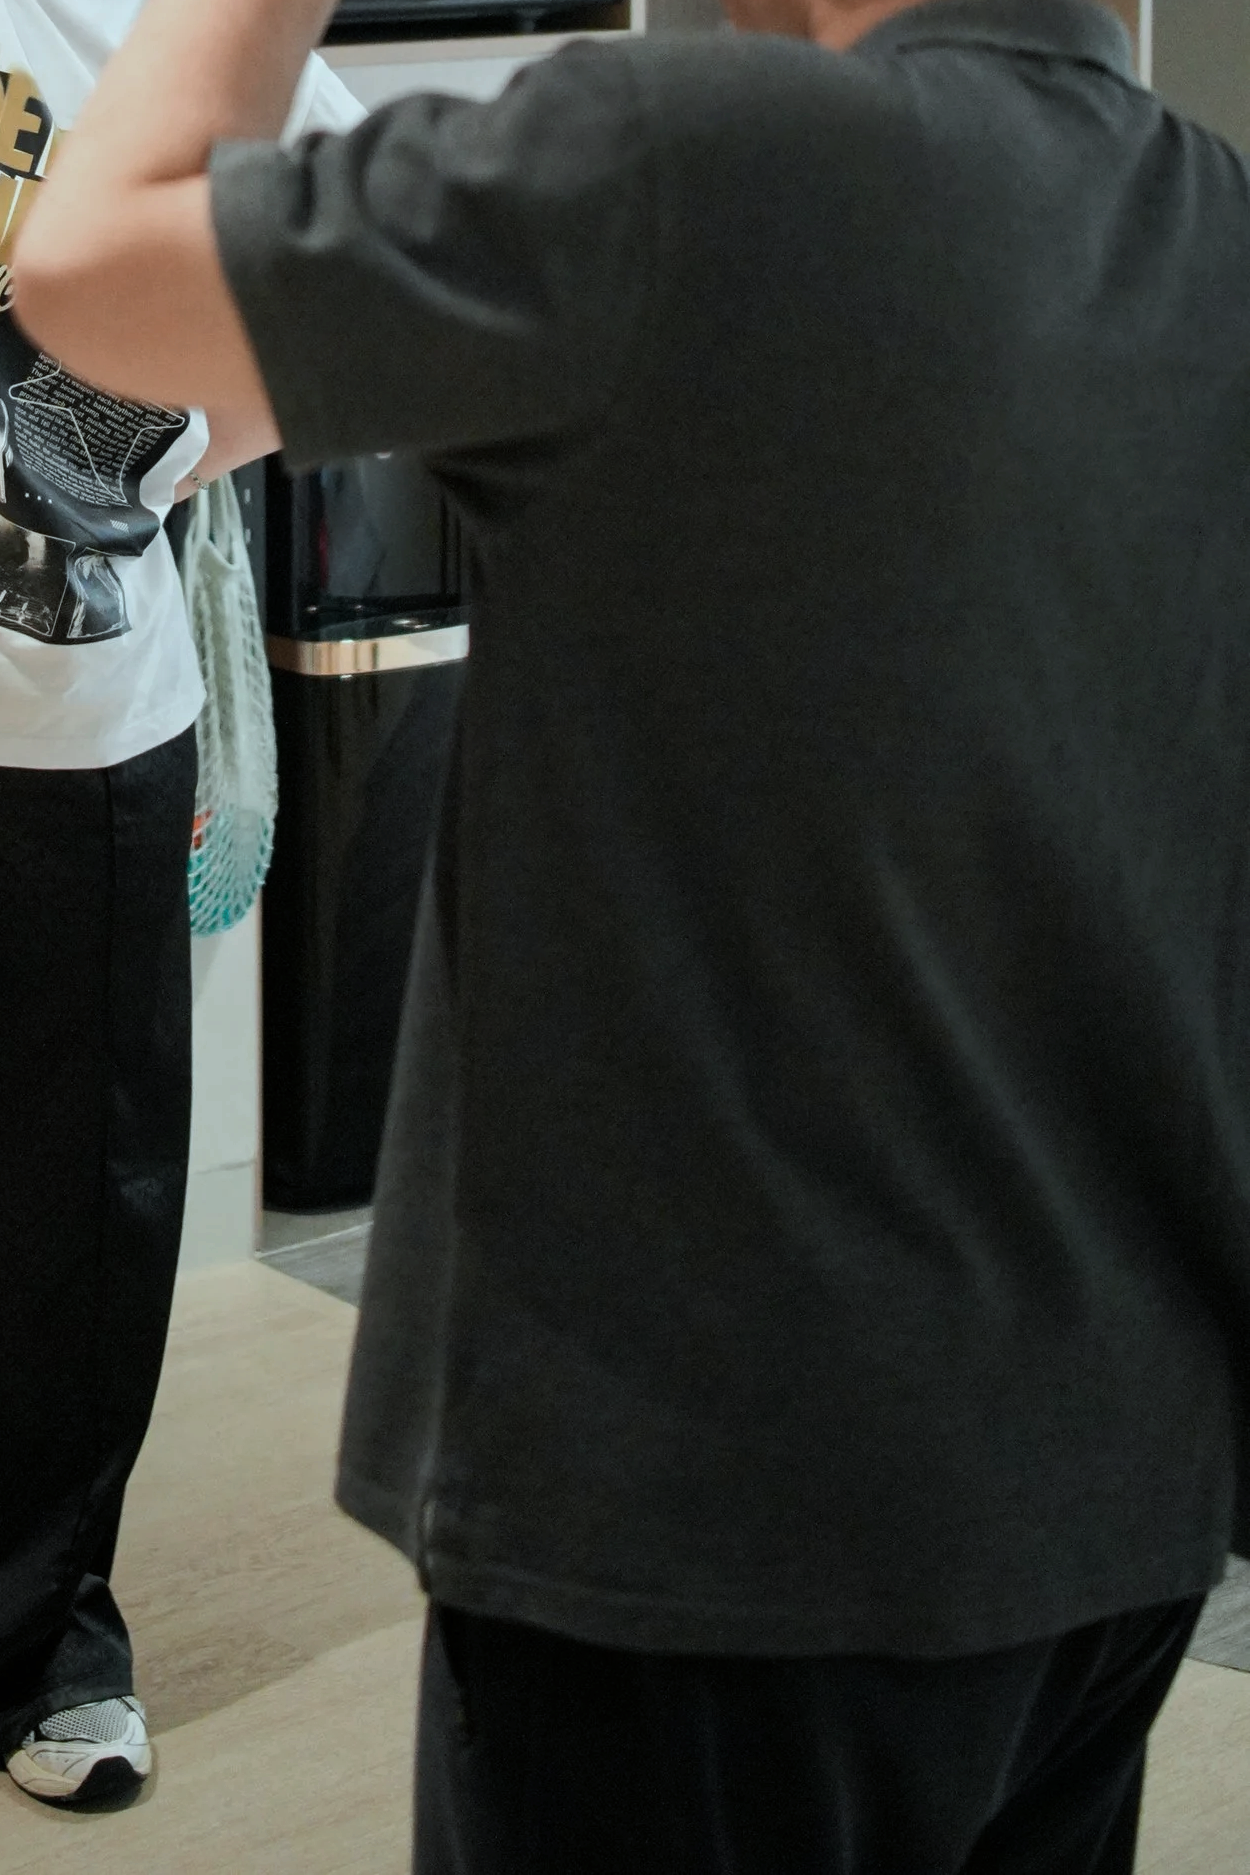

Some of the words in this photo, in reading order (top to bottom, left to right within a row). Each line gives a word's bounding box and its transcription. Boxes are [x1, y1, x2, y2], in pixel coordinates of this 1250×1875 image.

[34, 360, 48, 371] each
[97, 395, 111, 404] each
[112, 403, 134, 418] rhythm
[42, 373, 57, 385] oor
[60, 382, 83, 399] became
[93, 401, 124, 421] battlefield
[123, 401, 143, 413] corner
[65, 423, 84, 436] spars
[86, 434, 100, 445] from
[84, 424, 97, 434] that
[86, 417, 111, 434] pushing
